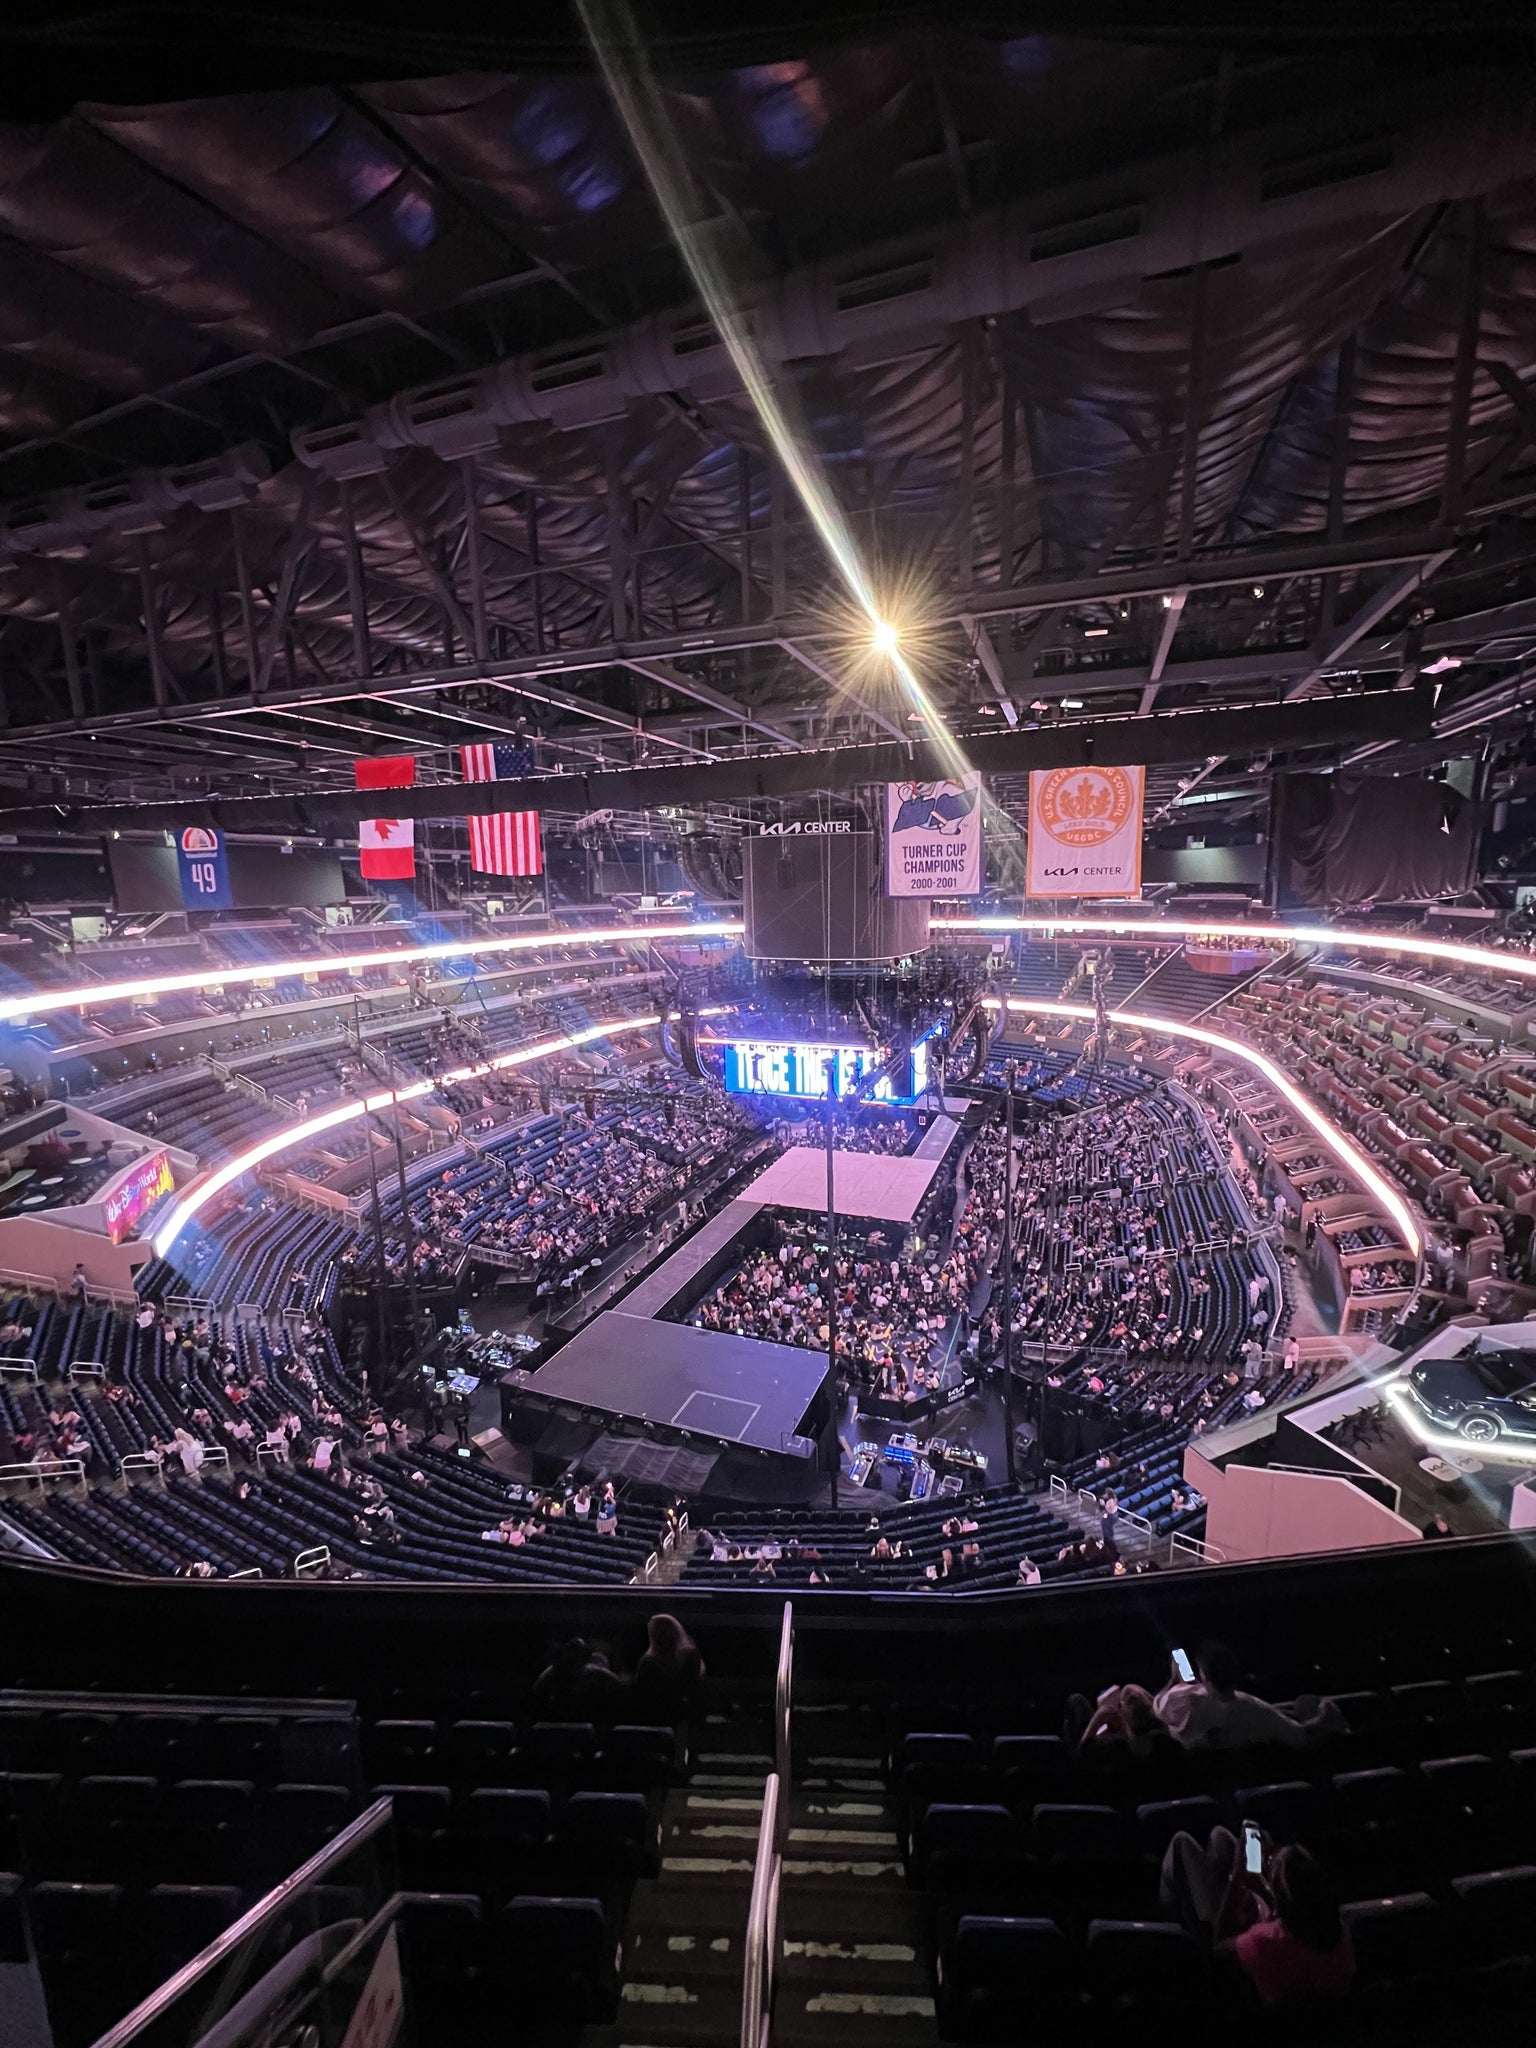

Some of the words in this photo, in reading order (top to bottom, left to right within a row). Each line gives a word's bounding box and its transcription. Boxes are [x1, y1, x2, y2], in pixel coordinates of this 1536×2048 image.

[1046, 770, 1067, 800] GREEN
[1113, 775, 1127, 817] COUNCIL
[760, 822, 800, 835] KIA
[804, 821, 850, 833] CENTER
[1066, 831, 1101, 842] USGBC
[902, 844, 943, 859] TURNER
[946, 843, 967, 857] CUP
[904, 859, 965, 874] CHAMPIONS
[1044, 868, 1078, 876] KIA
[1083, 866, 1122, 876] CENTER
[192, 863, 217, 893] 49
[911, 877, 957, 889] 2000-2001
